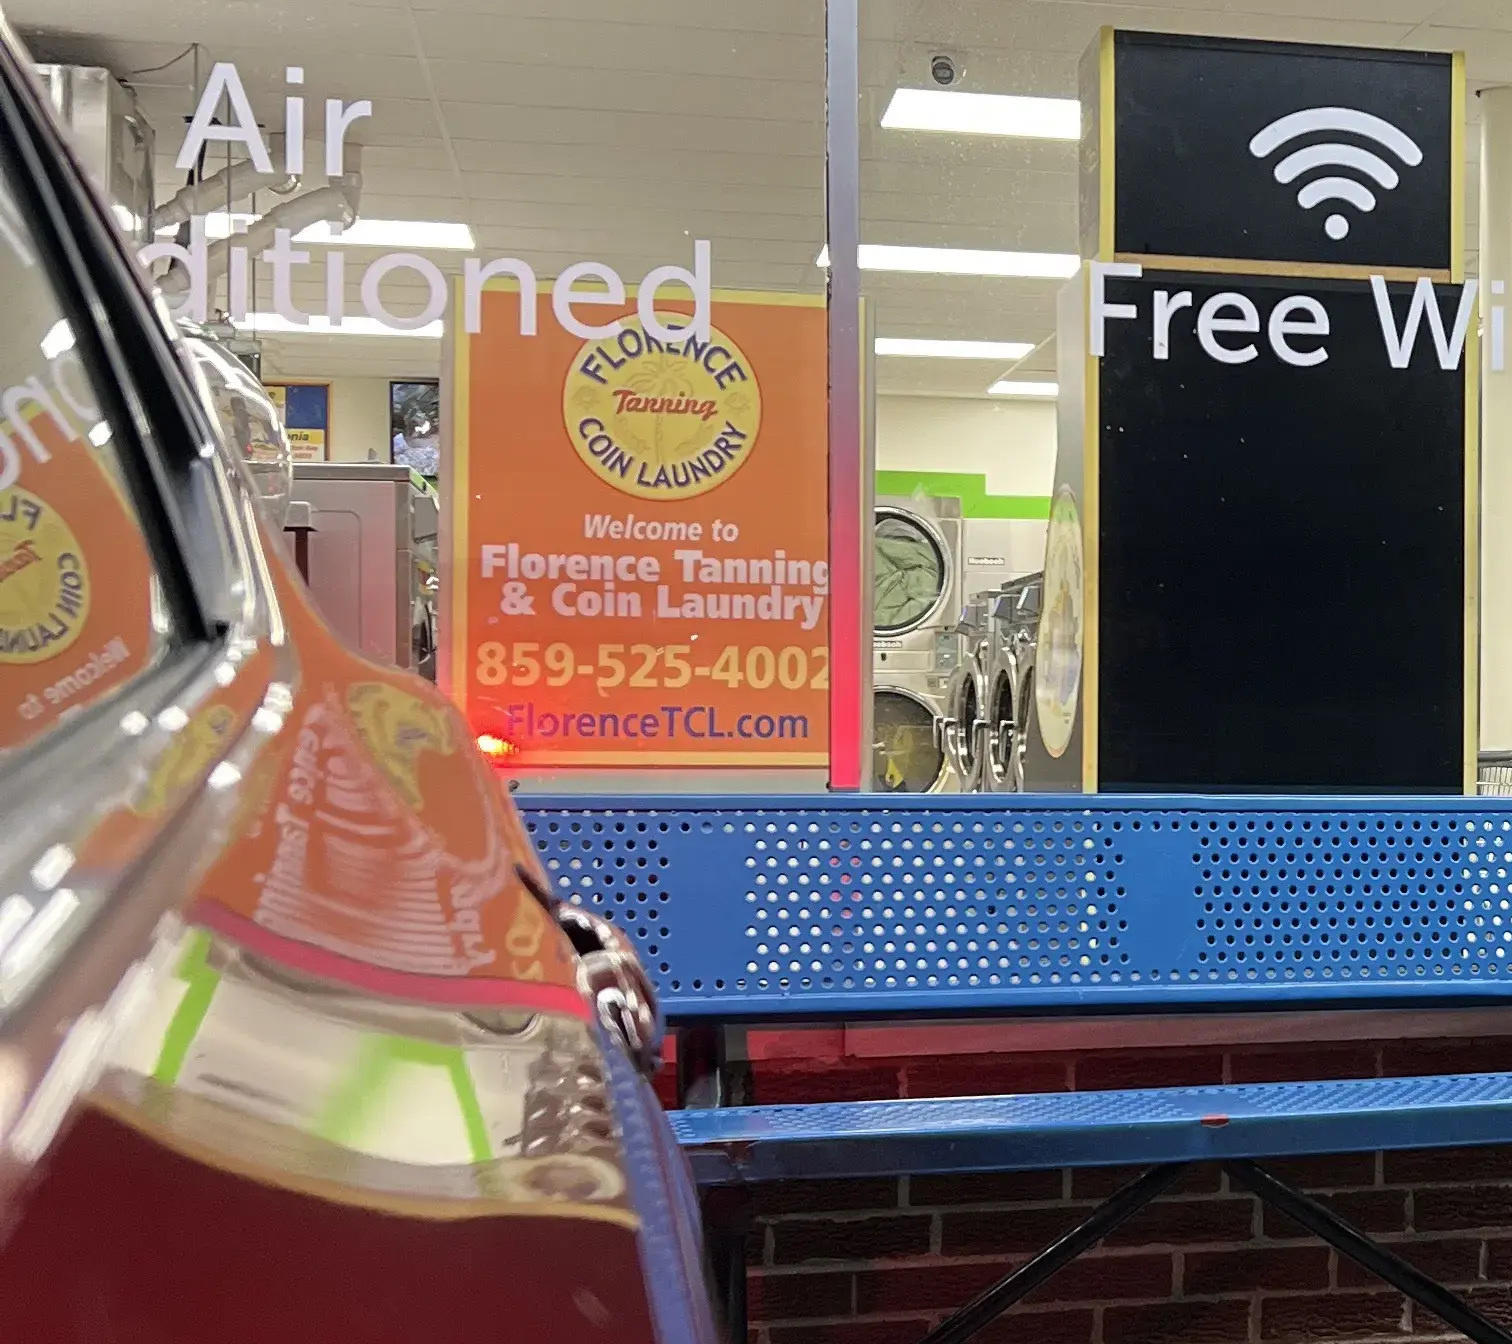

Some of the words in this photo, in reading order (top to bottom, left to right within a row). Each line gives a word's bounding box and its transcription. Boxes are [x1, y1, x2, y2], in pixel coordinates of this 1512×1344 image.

[175, 62, 372, 178] Air
[136, 214, 712, 343] ditioned
[1088, 262, 1330, 366] Free
[612, 389, 719, 421] Tanning
[578, 417, 634, 479] COIN
[636, 420, 748, 490] LAUNDRY
[584, 513, 703, 541] Welcome
[711, 518, 740, 543] to
[481, 544, 661, 582] Florence
[674, 548, 829, 595] Tanning
[500, 582, 536, 617] &
[552, 583, 642, 619] Coin
[658, 584, 825, 631] Laundry
[476, 640, 829, 691] 859-525-4002
[507, 703, 809, 739] FlorenceTCL.com
